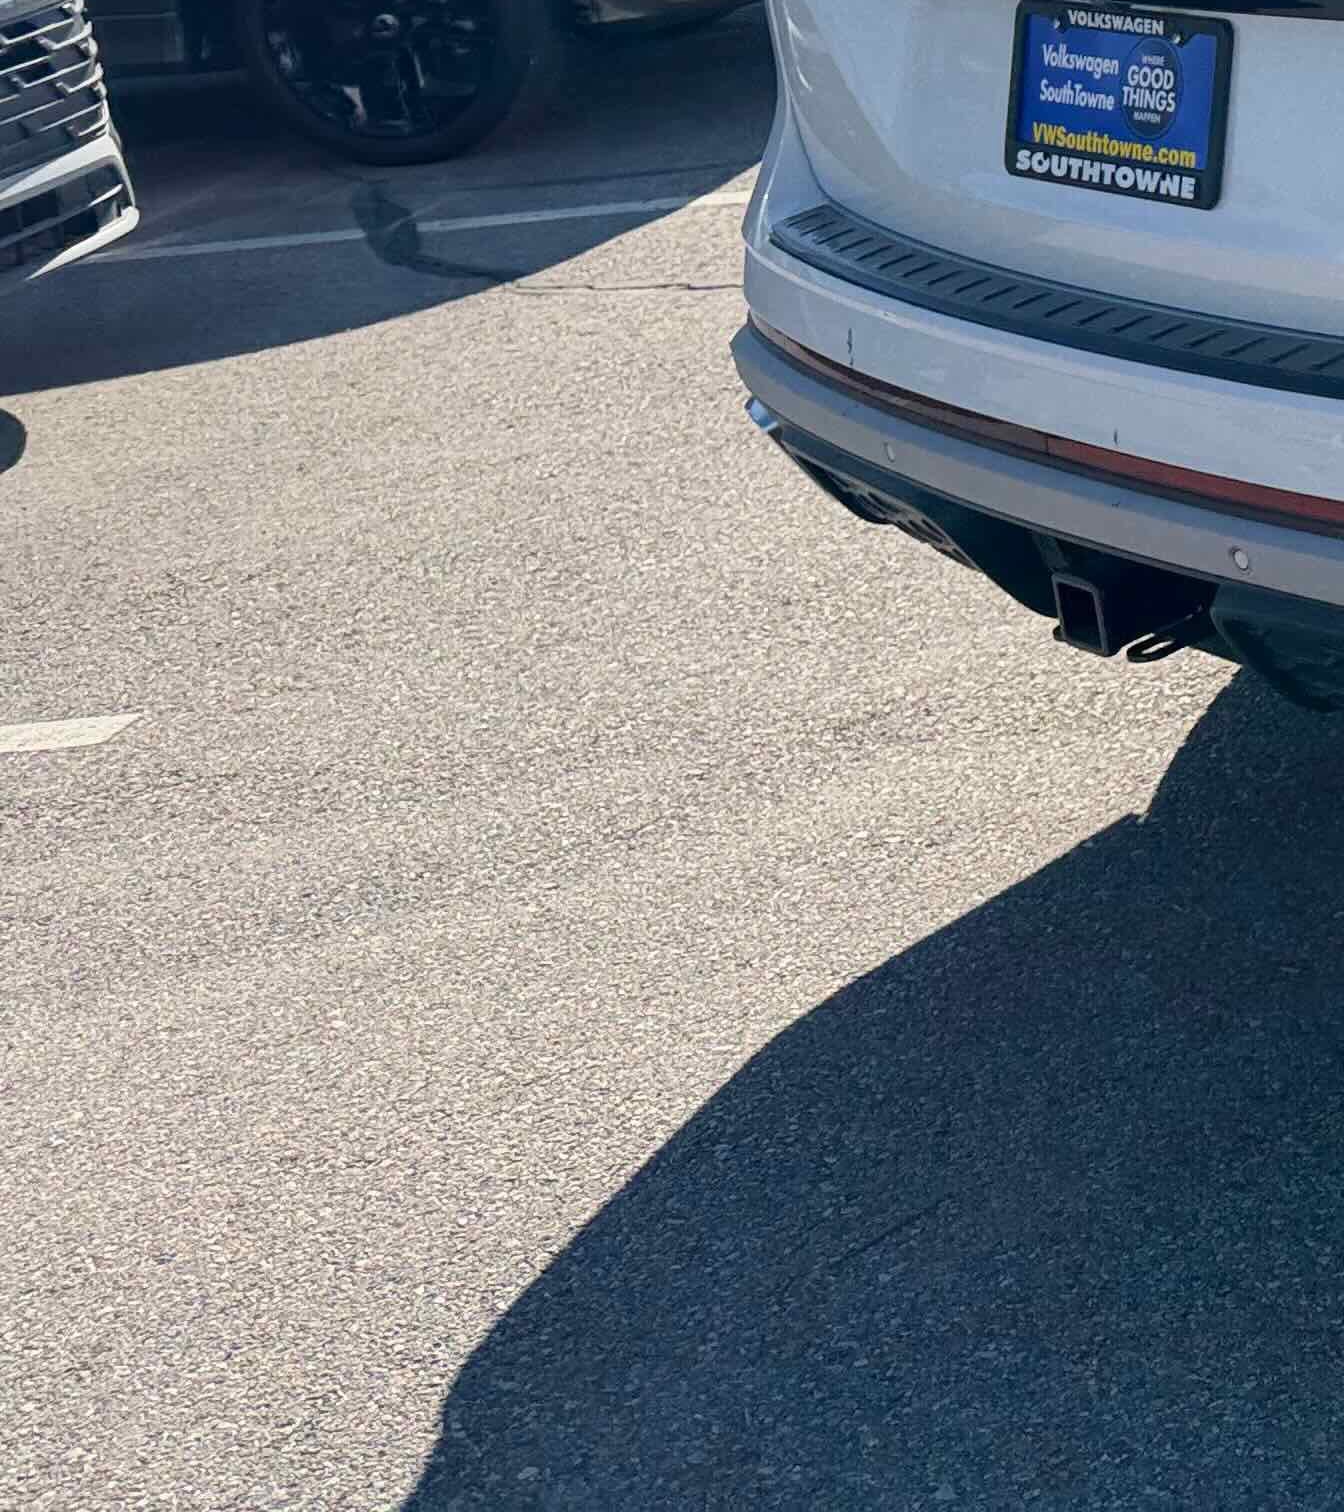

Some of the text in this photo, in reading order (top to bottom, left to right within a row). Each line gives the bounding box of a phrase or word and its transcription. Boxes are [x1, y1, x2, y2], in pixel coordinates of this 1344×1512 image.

[1068, 9, 1164, 36] VOLKSWAGEN
[1042, 44, 1120, 79] Volkswagen
[1127, 65, 1175, 90] GOOD
[1039, 79, 1115, 112] SouthTowne
[1121, 86, 1176, 113] THINGS
[1033, 121, 1197, 169] VWSouthtowne.com
[1015, 149, 1197, 200] SOUTHTOWNE
